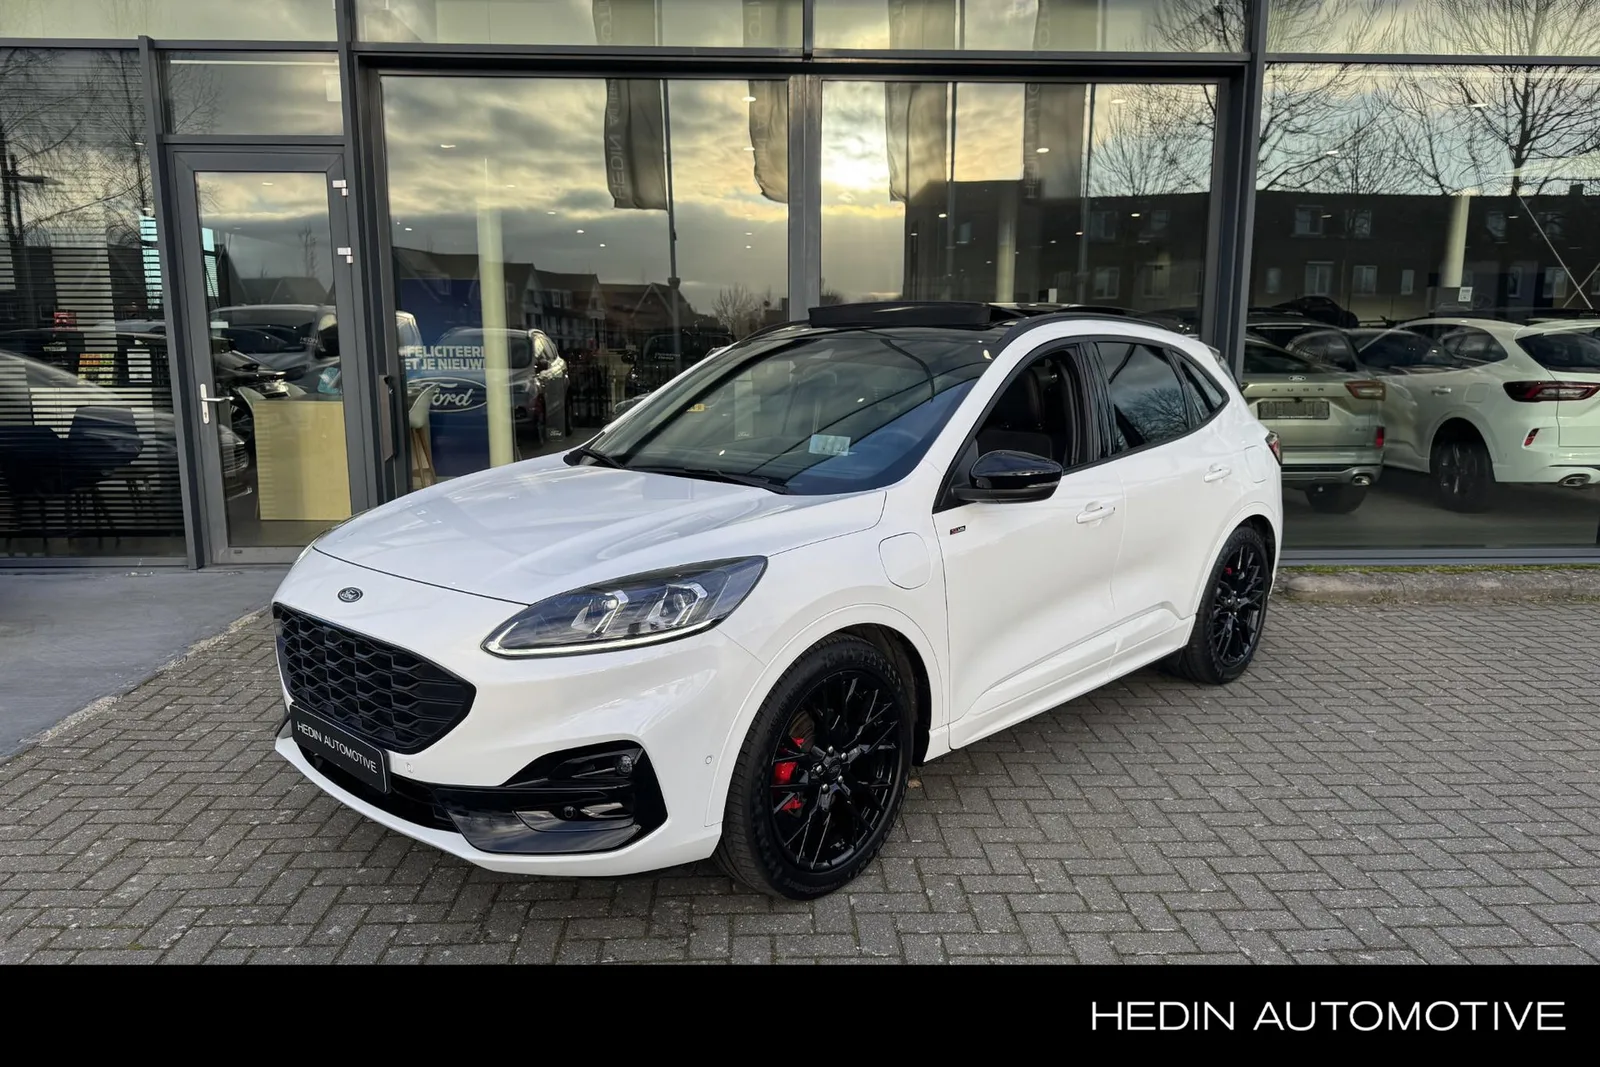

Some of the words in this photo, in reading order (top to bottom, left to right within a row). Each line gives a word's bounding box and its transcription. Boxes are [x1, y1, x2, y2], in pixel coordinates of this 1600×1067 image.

[405, 358, 419, 369] ET
[421, 358, 437, 370] JE
[438, 358, 485, 370] NIEUW
[296, 721, 322, 742] HEDIN
[324, 735, 377, 774] AUTOMOTIVE
